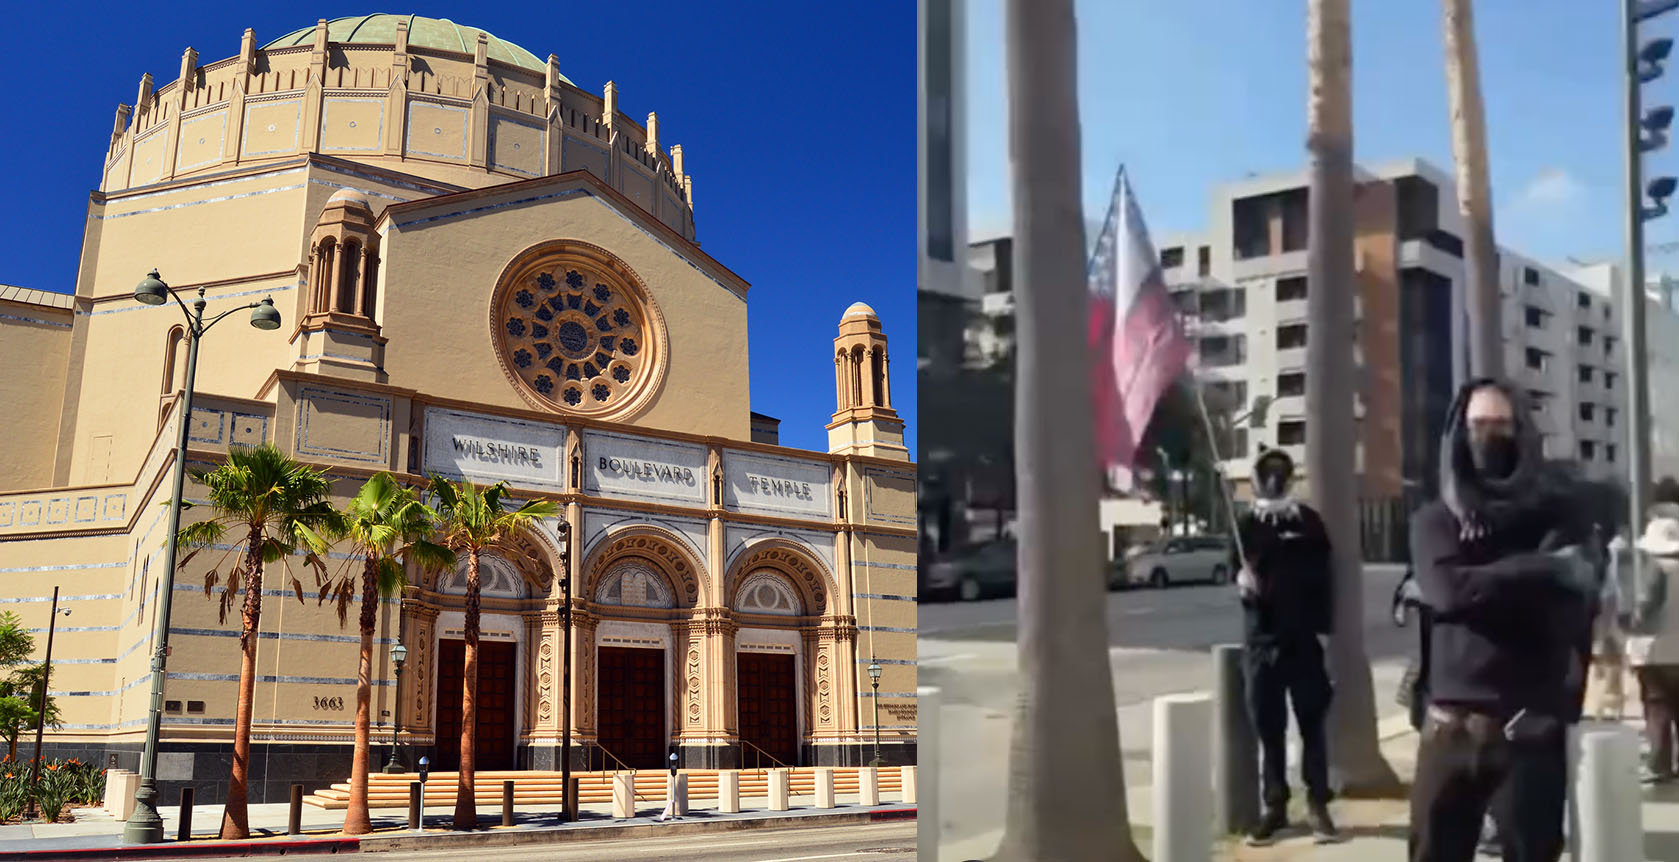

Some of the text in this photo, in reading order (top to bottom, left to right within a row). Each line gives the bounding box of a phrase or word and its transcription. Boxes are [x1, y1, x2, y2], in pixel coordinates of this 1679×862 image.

[452, 437, 809, 496] WILSHIRE BOULEVARD TEMPLE
[312, 695, 344, 711] 3663
